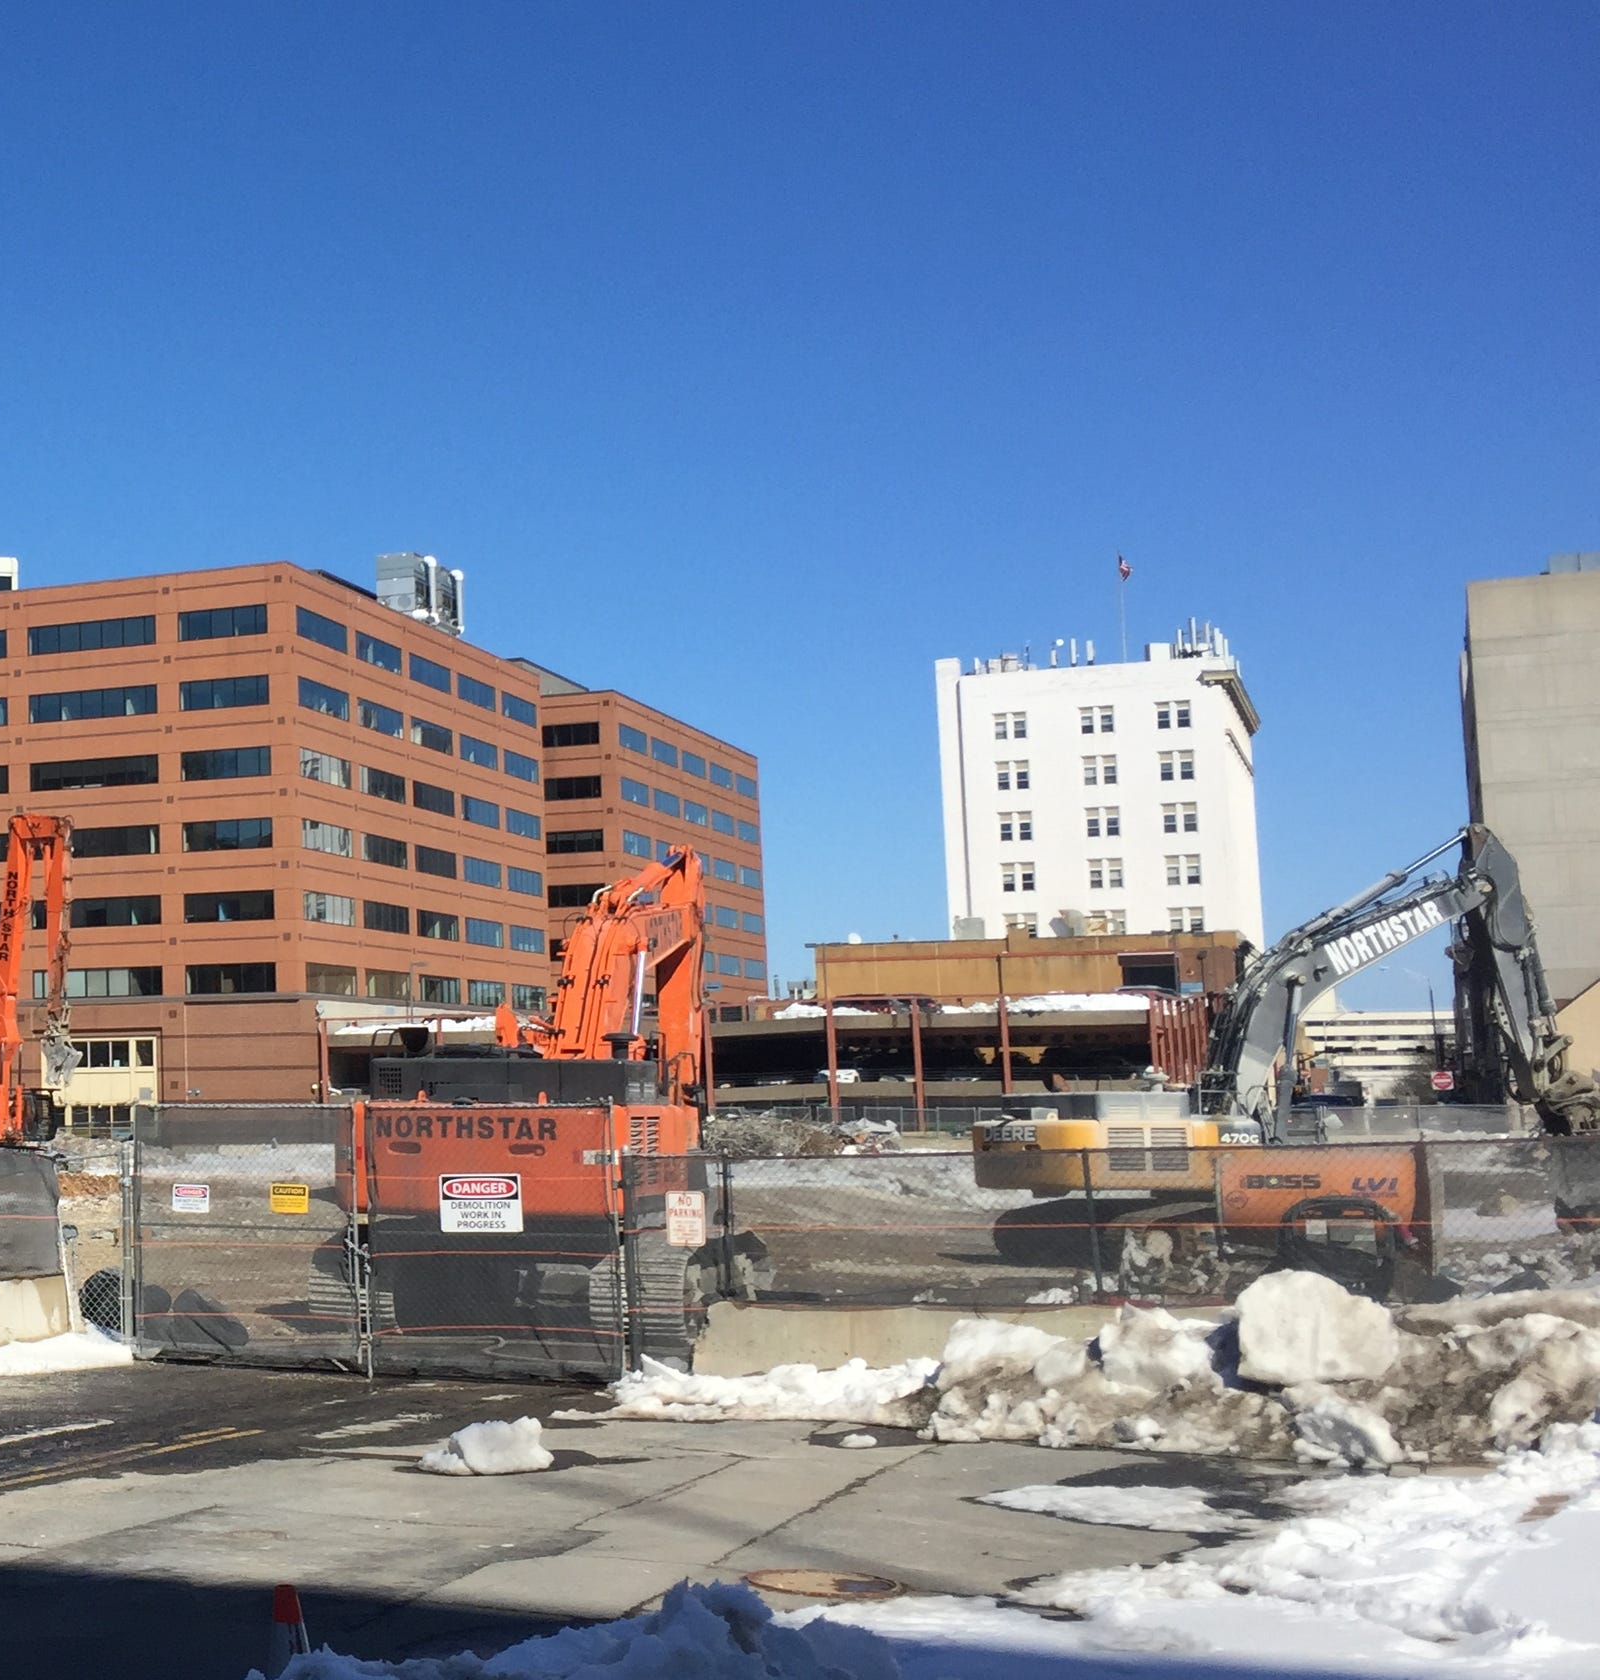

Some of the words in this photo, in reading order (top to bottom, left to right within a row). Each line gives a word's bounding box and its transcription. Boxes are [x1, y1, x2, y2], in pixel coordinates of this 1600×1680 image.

[1323, 900, 1444, 975] NORTHSTAR
[375, 1115, 557, 1141] NORTHSTAR
[983, 1126, 1036, 1142] DEERE
[1220, 1132, 1260, 1144] 470G
[451, 1182, 507, 1194] DANGER
[1246, 1174, 1321, 1190] BOSS
[273, 1187, 305, 1195] CAUTION
[450, 1201, 511, 1210] DEMOLITION
[678, 1196, 692, 1207] NO
[460, 1211, 489, 1219] WORK
[491, 1211, 502, 1219] IN
[457, 1220, 507, 1229] PROGRESS
